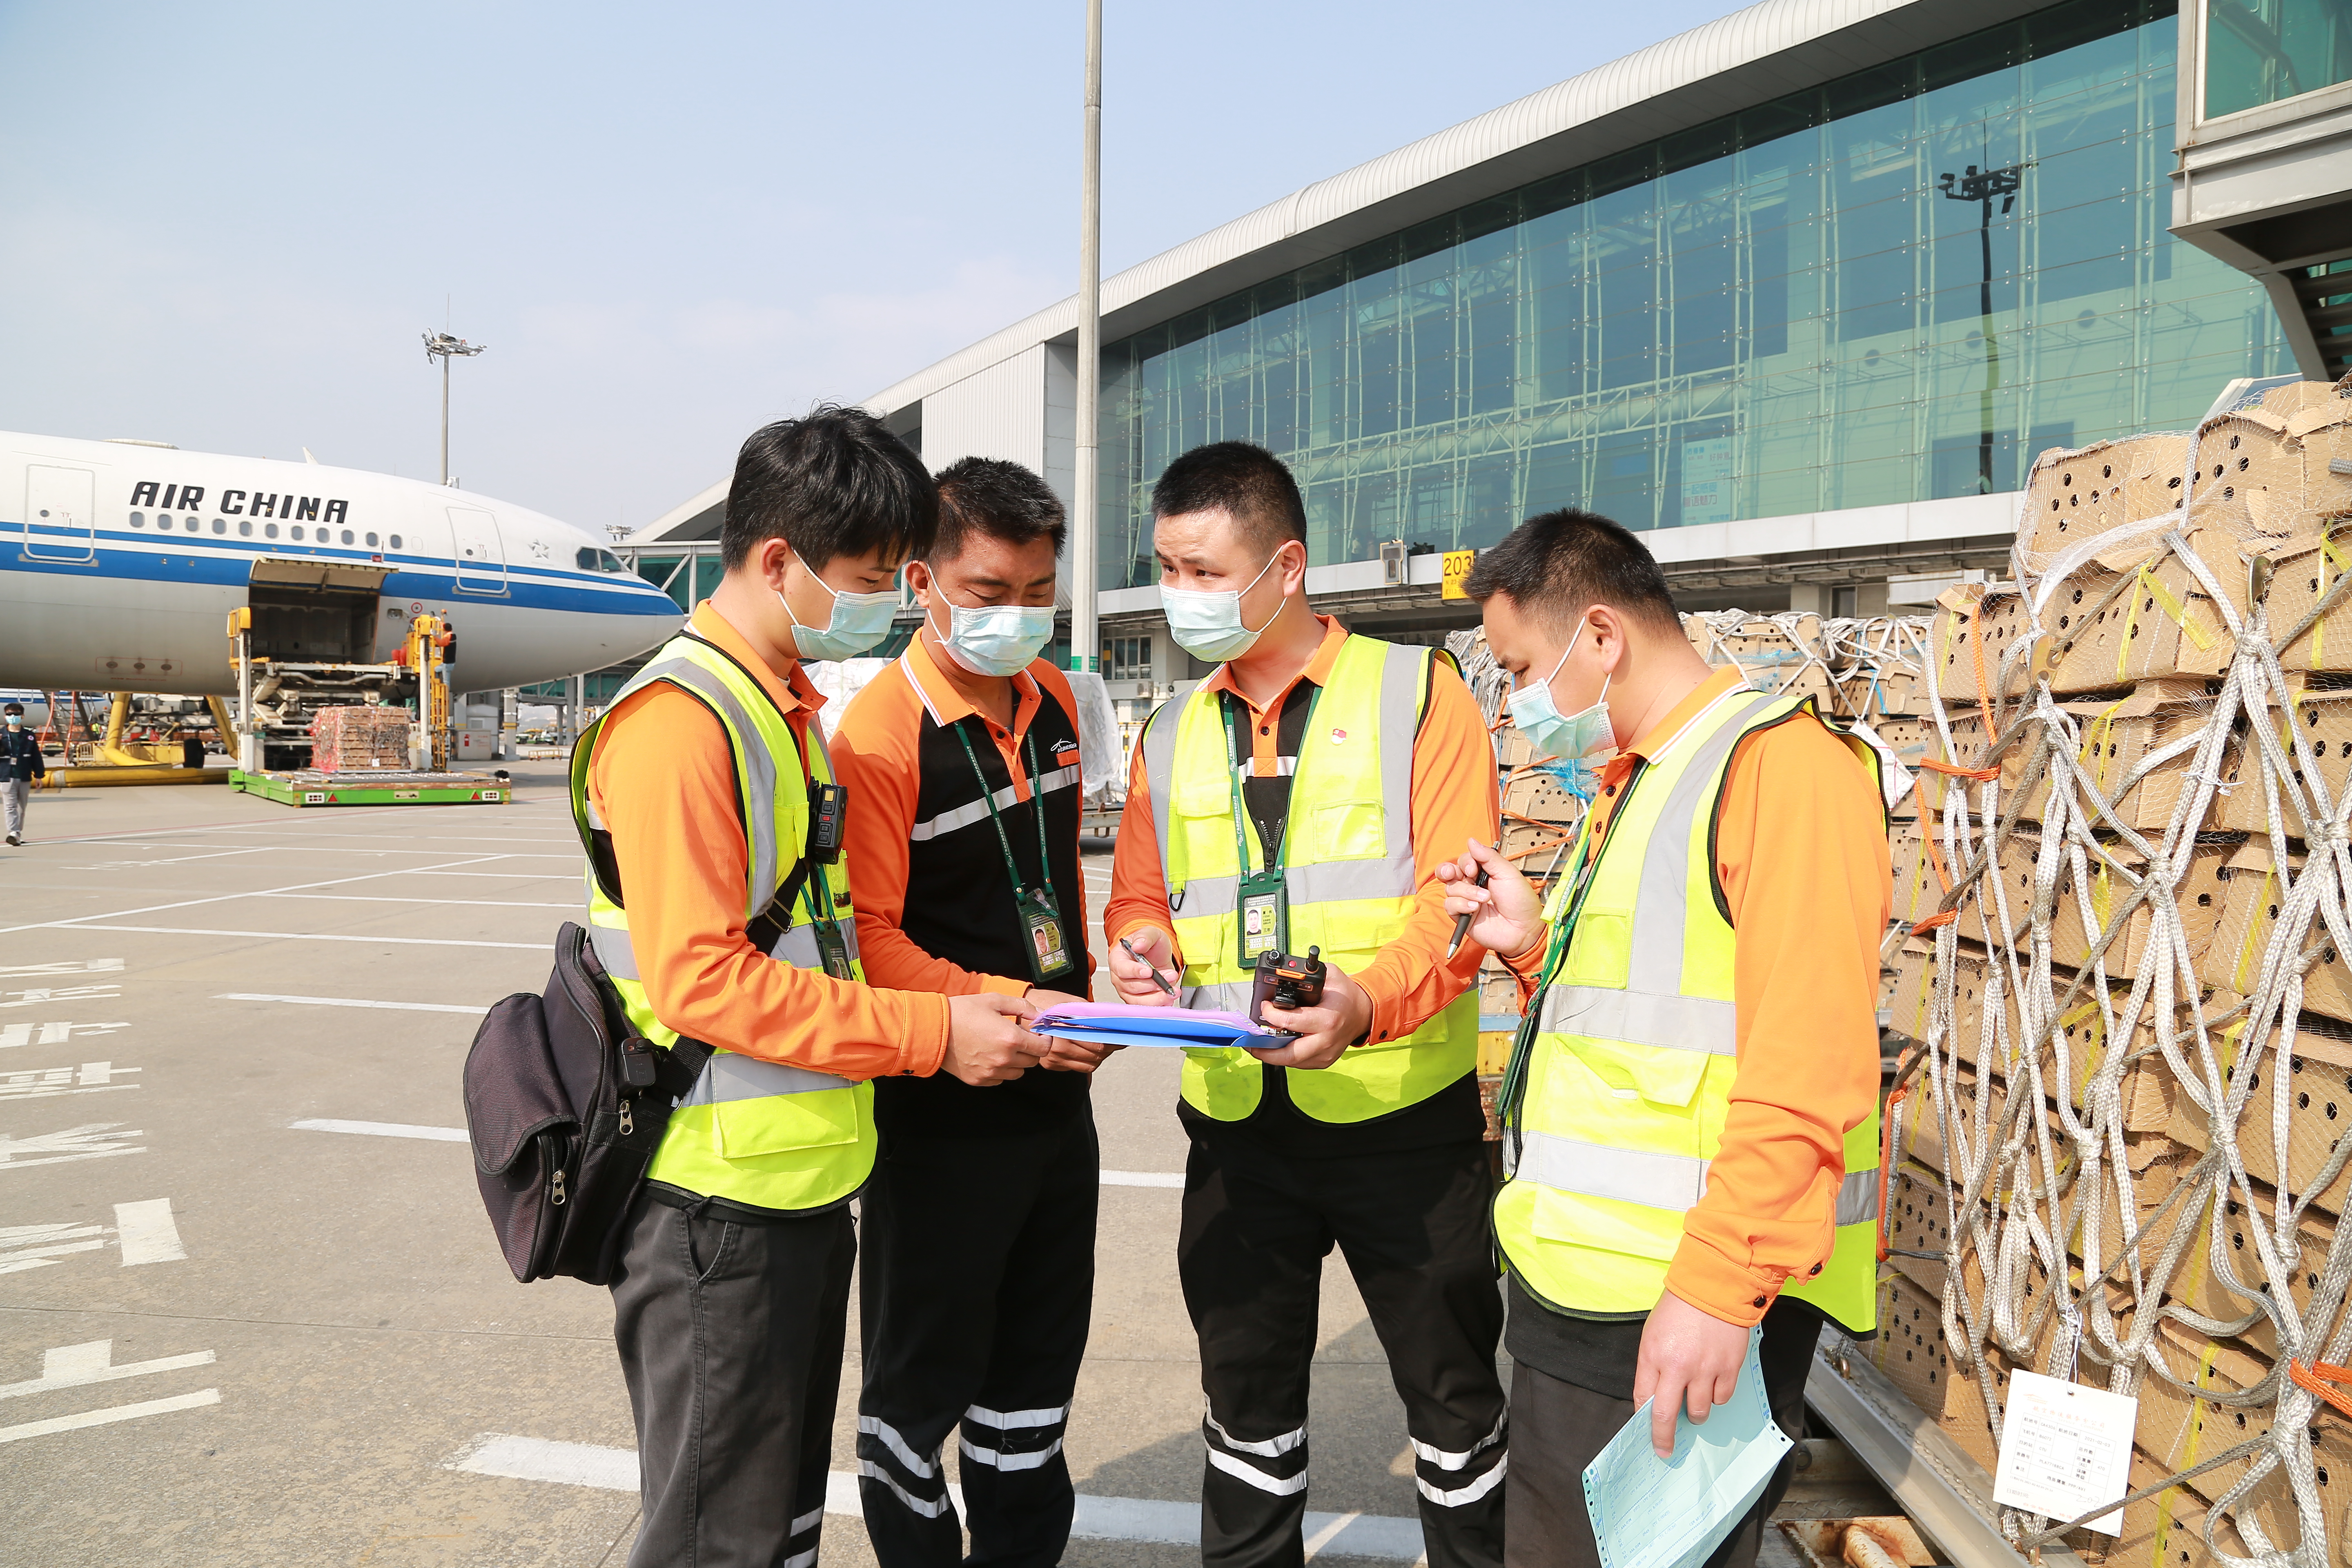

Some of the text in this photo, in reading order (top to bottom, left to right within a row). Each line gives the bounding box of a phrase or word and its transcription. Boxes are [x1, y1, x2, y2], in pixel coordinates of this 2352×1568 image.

[130, 481, 349, 524] AIR CHINA
[1444, 555, 1472, 576] 203
[2023, 1417, 2038, 1425] 航班号
[2040, 1422, 2056, 1430] CA4306
[2022, 1428, 2036, 1437] 飞机号
[2058, 1427, 2079, 1438] 航班日期
[2019, 1439, 2033, 1448] 目的站
[2084, 1436, 2111, 1448] 2021-02-03
